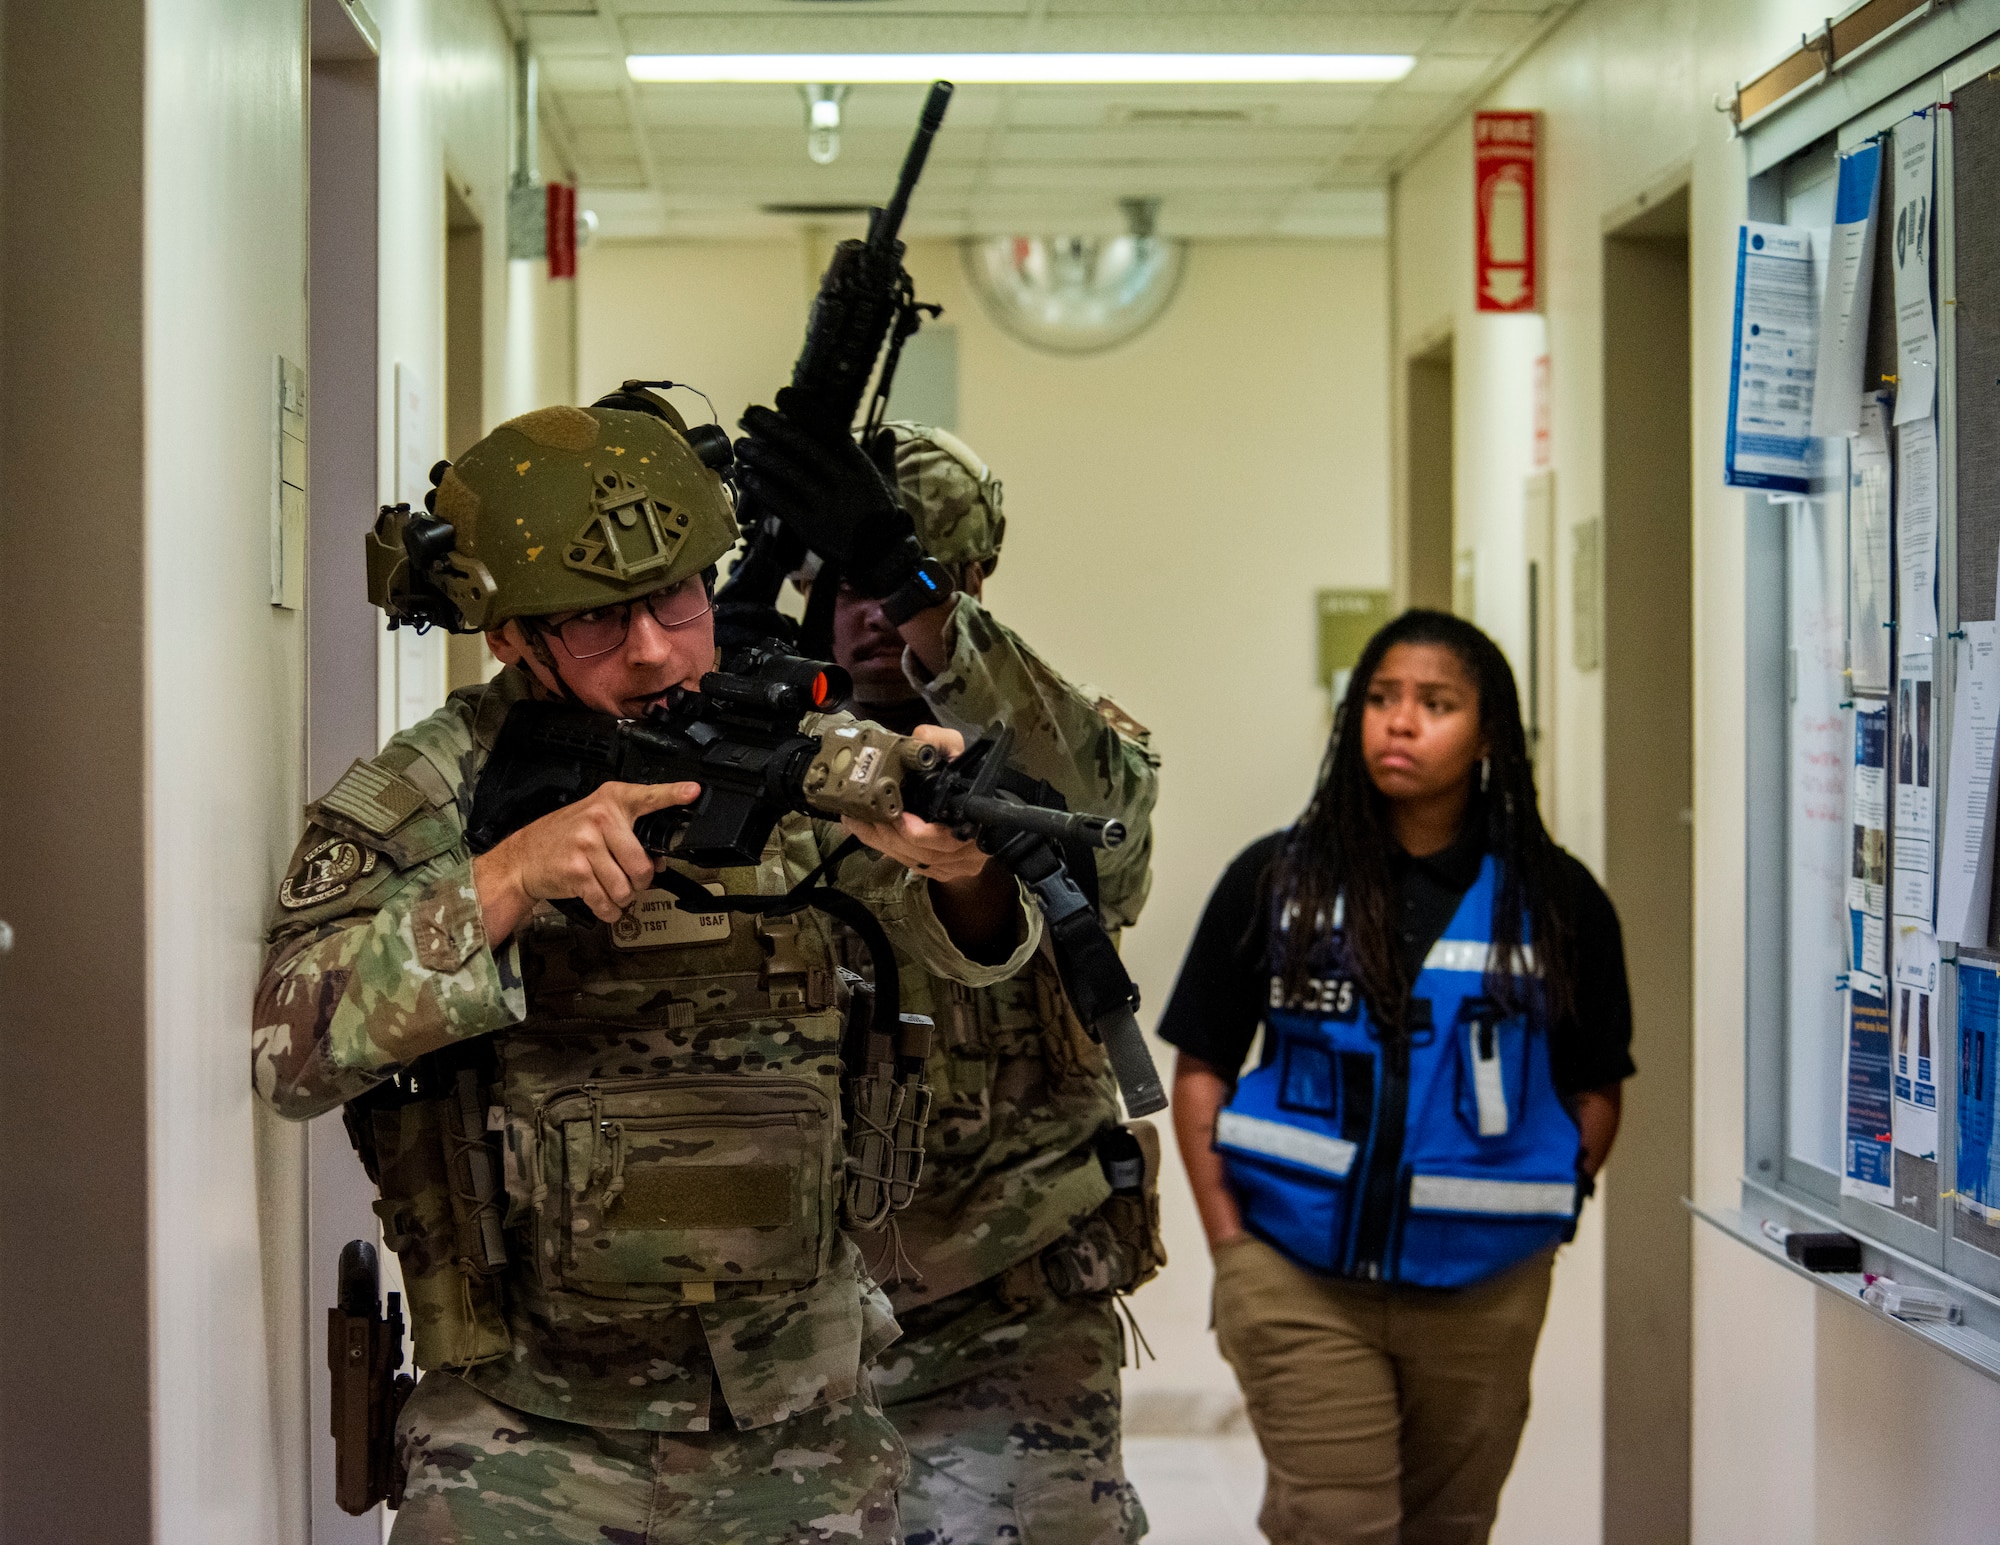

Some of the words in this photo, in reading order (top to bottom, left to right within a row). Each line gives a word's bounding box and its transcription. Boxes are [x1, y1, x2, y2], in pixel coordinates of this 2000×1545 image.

[641, 901, 672, 912] JUSTYN
[643, 920, 668, 931] TSGT
[700, 915, 725, 927] USAF
